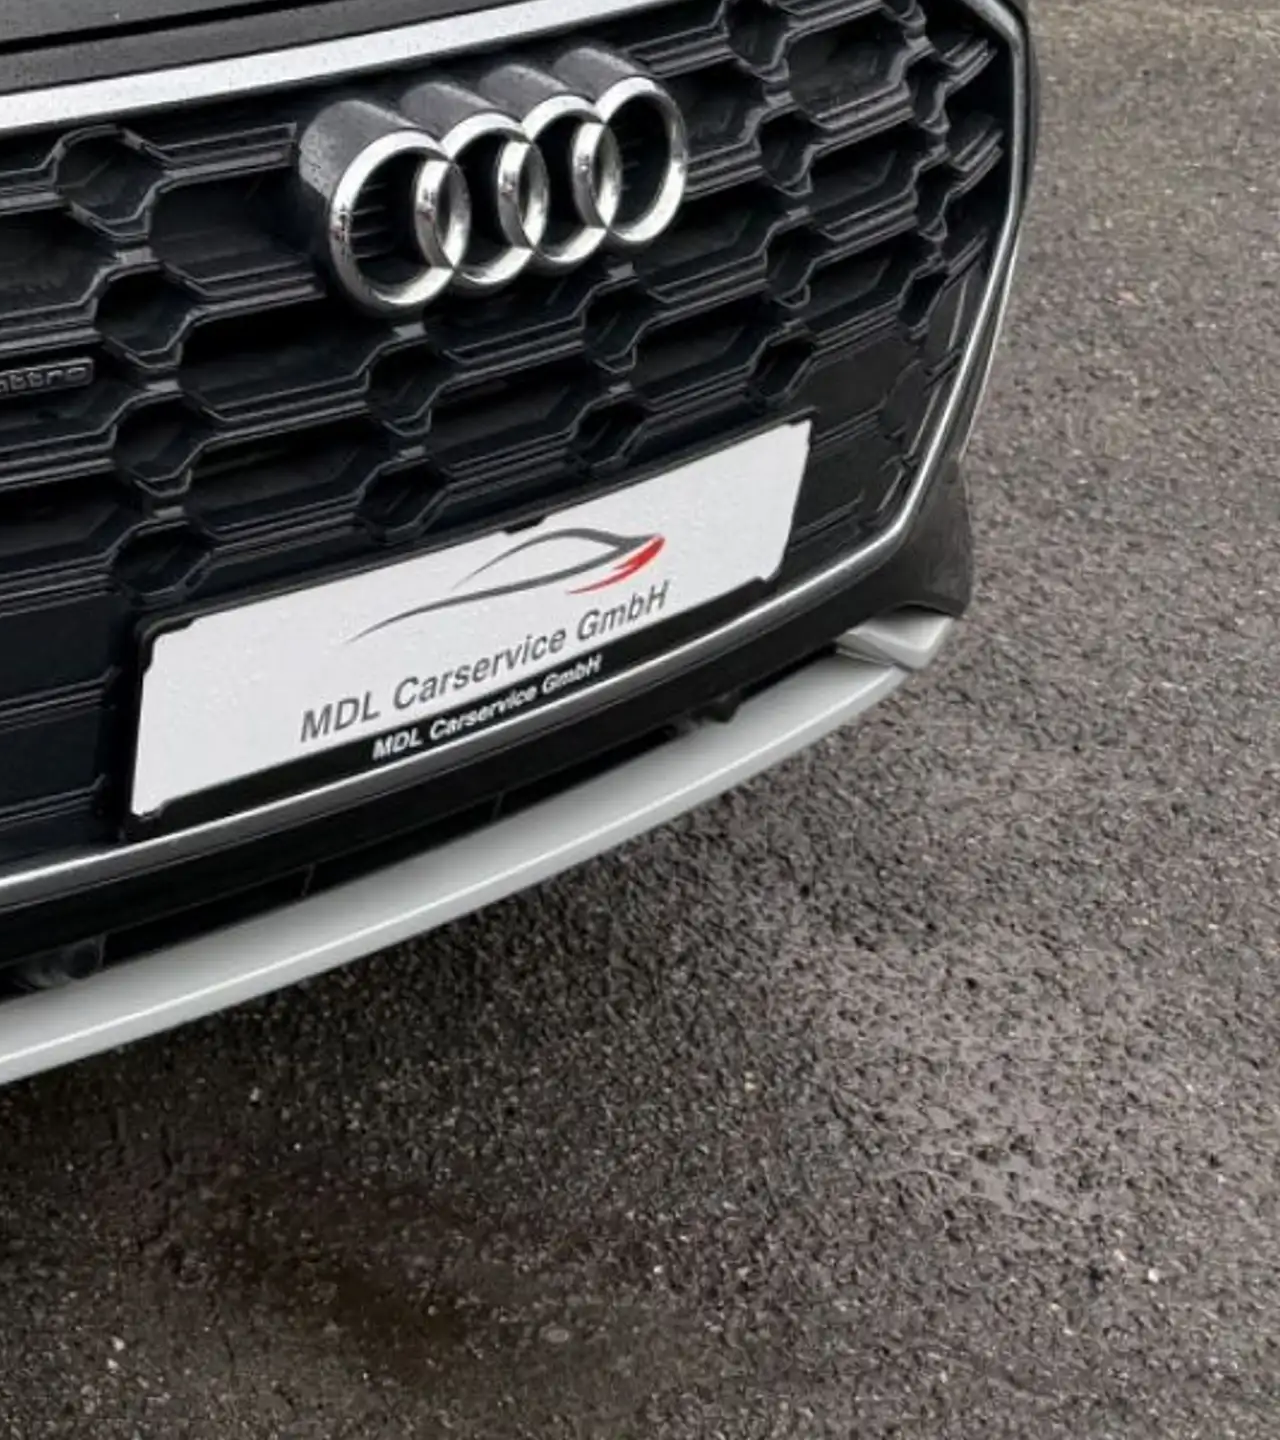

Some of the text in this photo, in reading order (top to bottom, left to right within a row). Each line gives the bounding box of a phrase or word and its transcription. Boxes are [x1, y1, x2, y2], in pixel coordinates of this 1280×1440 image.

[300, 579, 671, 743] MDL Carservice GmbH
[371, 654, 604, 761] MDL Carservice GmbH
